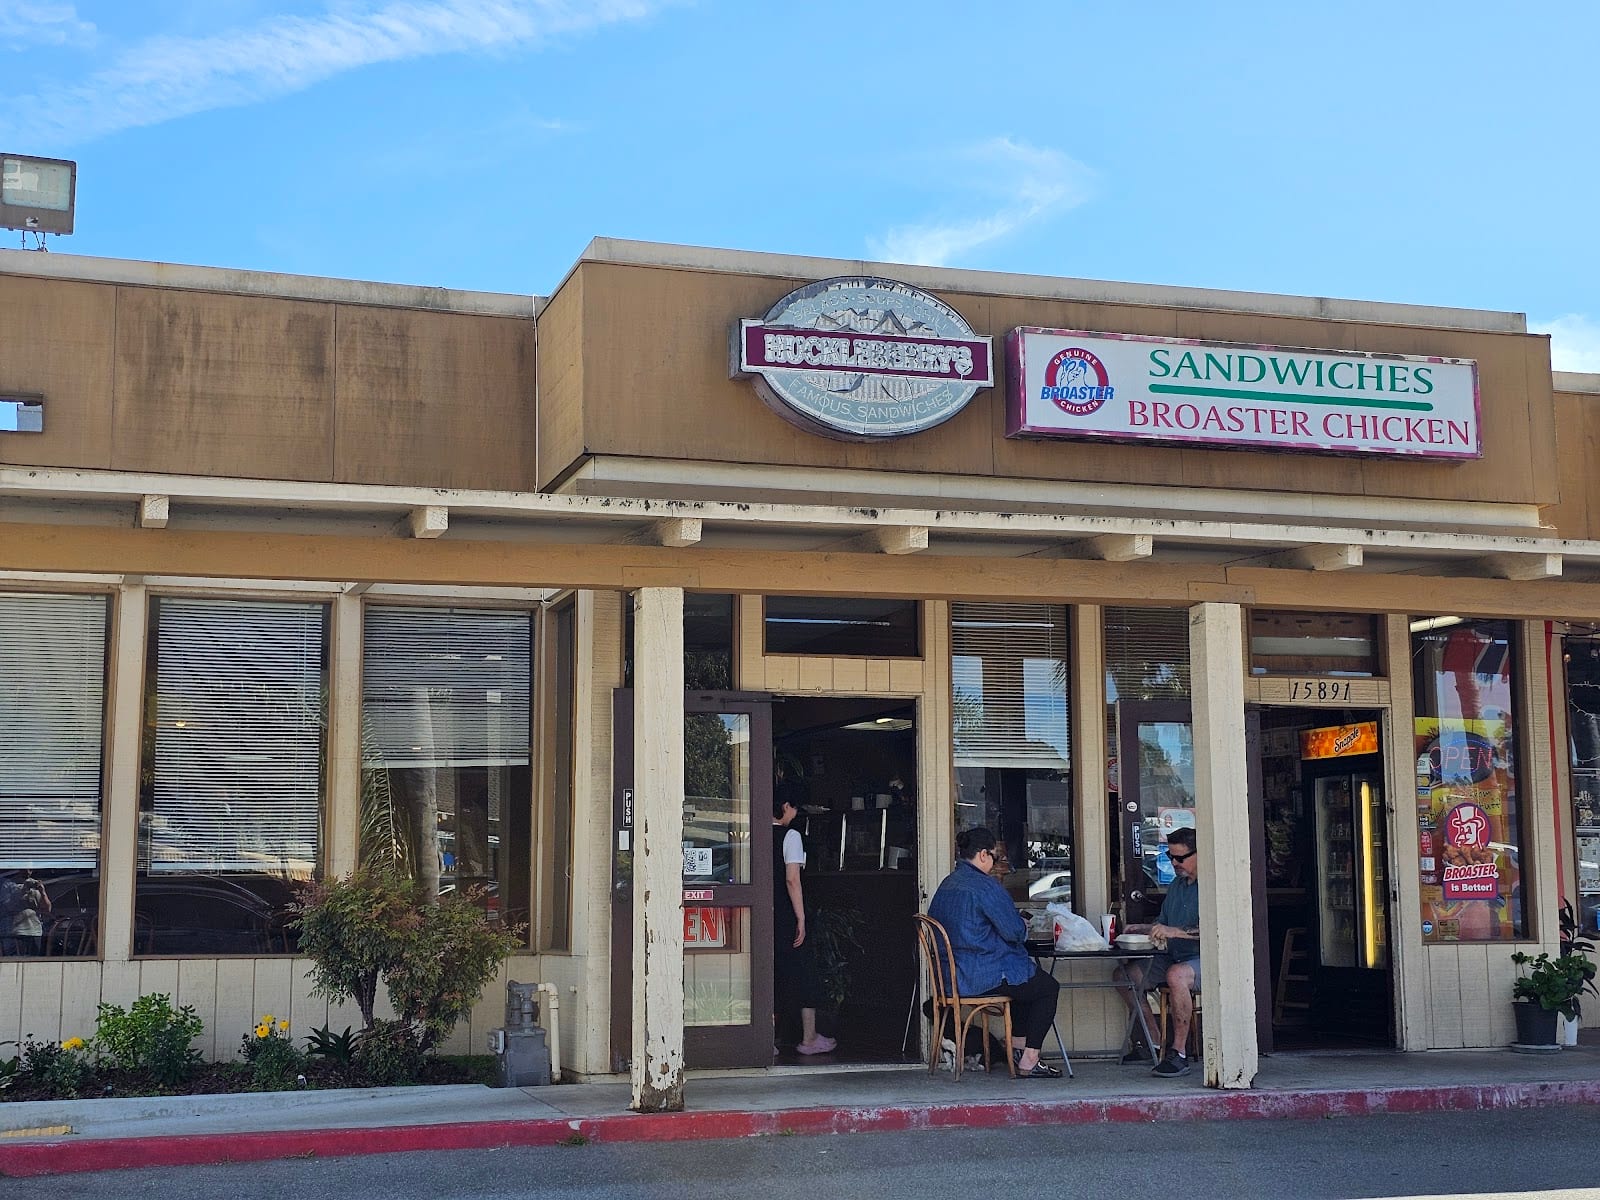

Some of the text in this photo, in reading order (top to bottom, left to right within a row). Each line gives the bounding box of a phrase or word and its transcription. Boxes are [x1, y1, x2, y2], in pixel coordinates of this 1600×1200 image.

[857, 293, 904, 310] SOUPS
[913, 305, 948, 330] GRILL
[1054, 350, 1098, 366] GENUINE
[1149, 348, 1434, 395] SANDWICHES
[790, 380, 955, 420] FAMOUS SANDWICHES
[1040, 386, 1115, 400] BROASTER
[1060, 400, 1099, 413] CHICKEN
[1128, 400, 1470, 447] BROASTER CHICKEN
[1291, 682, 1350, 701] 15891
[1334, 727, 1360, 753] Snapple
[1429, 746, 1493, 770] OPEN
[1443, 864, 1496, 881] BROASTER
[684, 890, 706, 899] EXIT
[1461, 883, 1493, 892] Better!
[683, 906, 720, 943] EN
